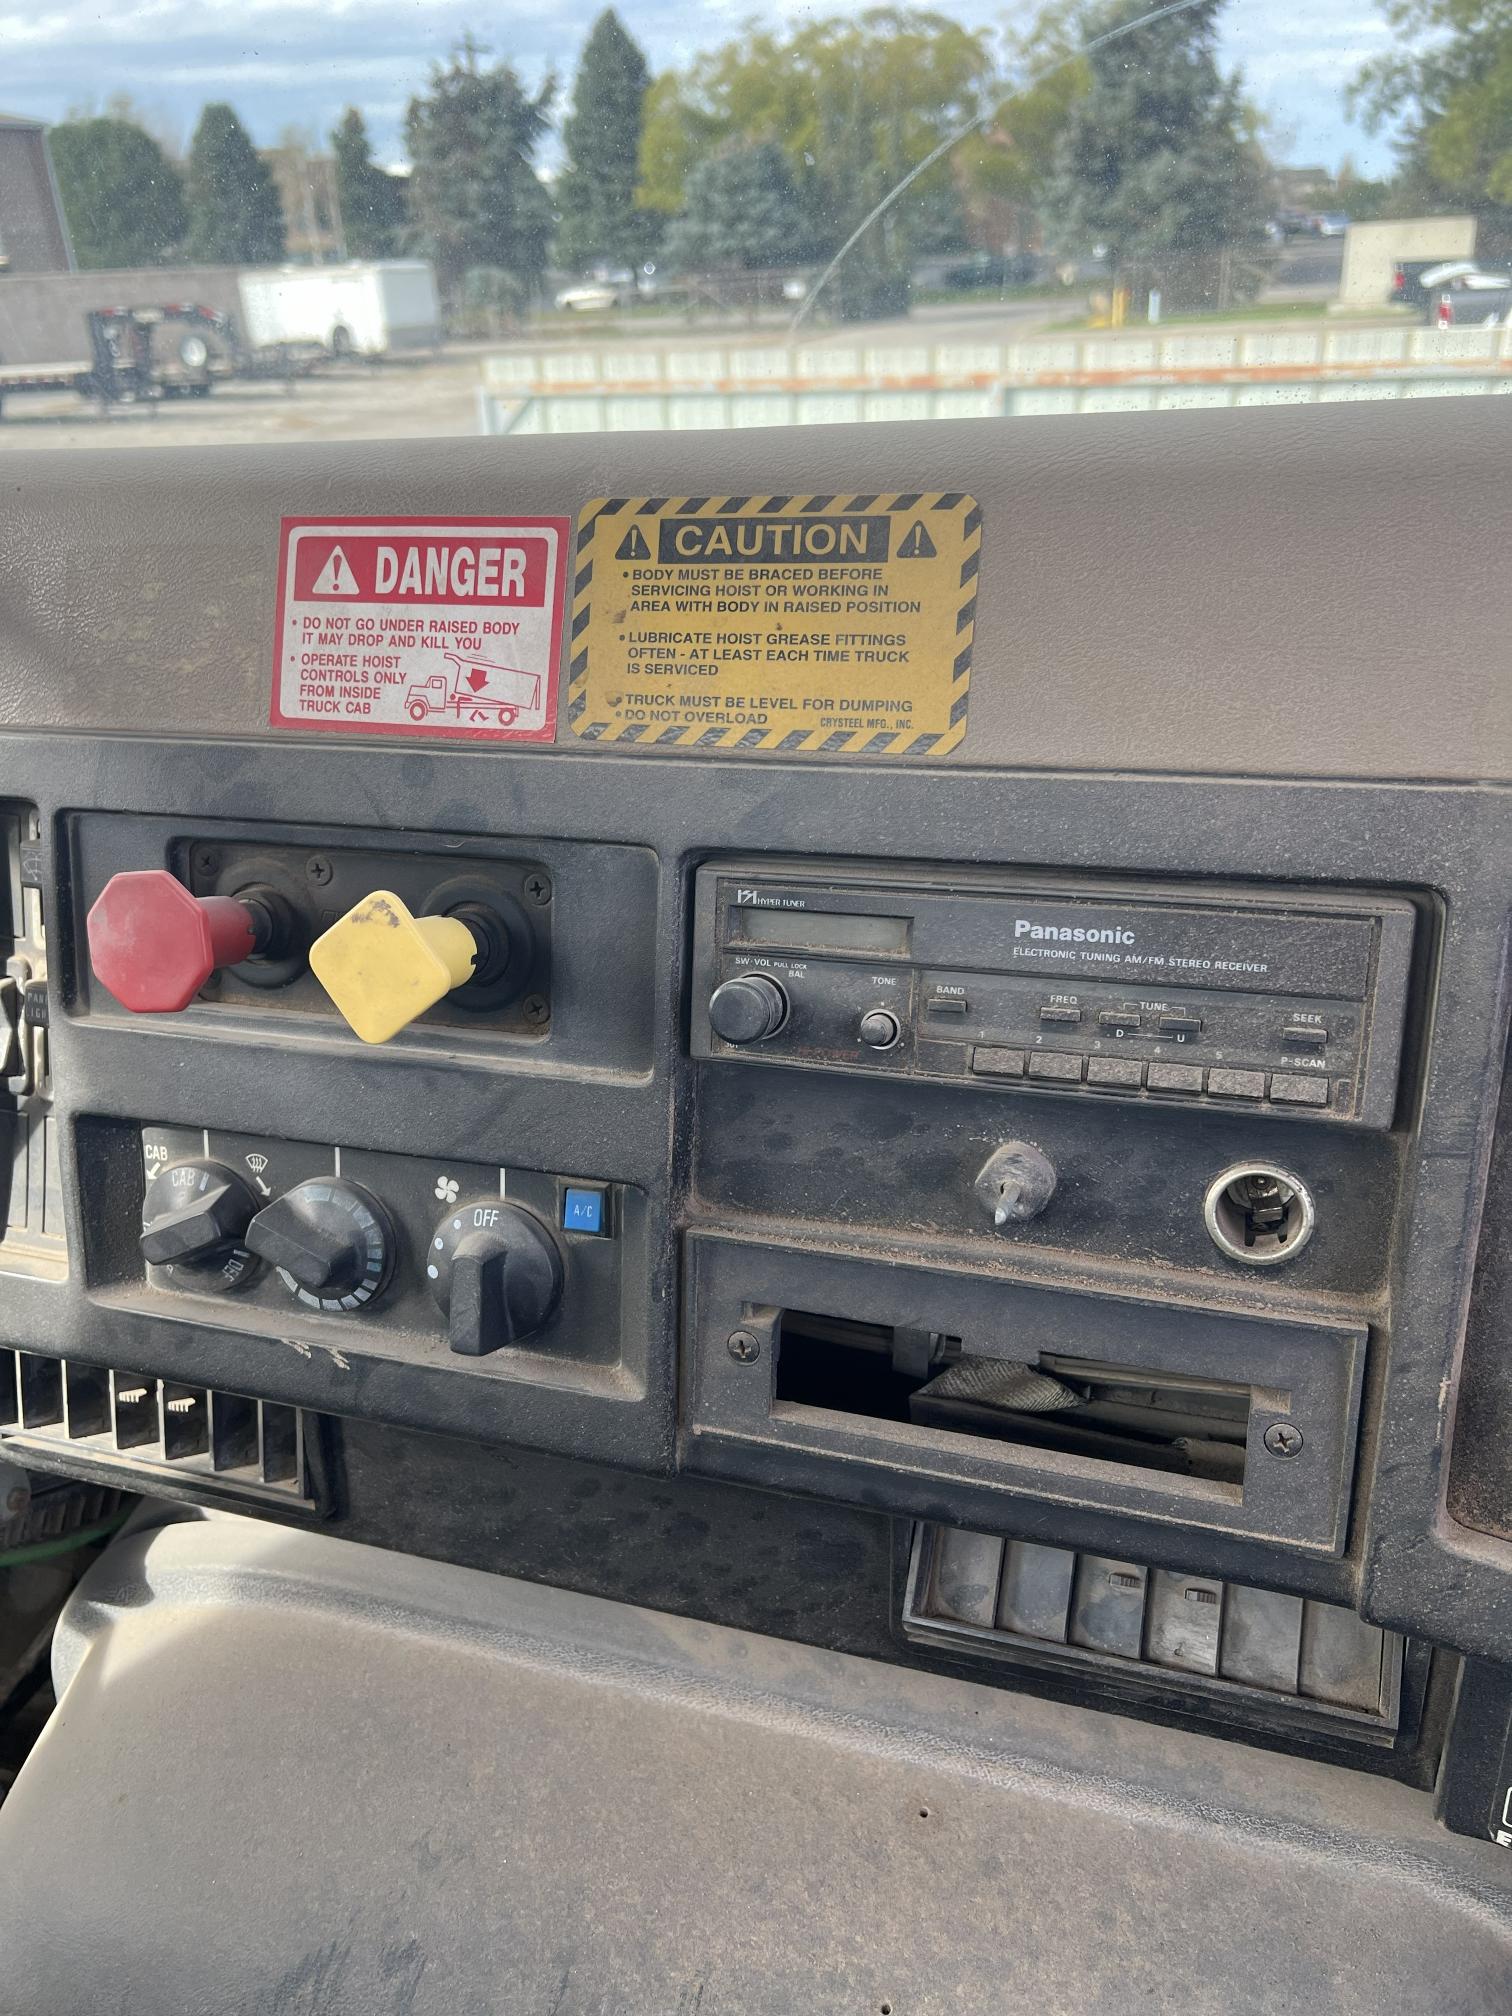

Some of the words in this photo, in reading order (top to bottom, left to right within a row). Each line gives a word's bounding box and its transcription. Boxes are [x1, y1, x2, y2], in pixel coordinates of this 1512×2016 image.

[674, 523, 868, 556] CAUTION
[375, 546, 526, 597] DANGER
[633, 569, 673, 581] BODY
[678, 569, 720, 581] MUST
[724, 569, 745, 580] BE
[749, 569, 814, 580] BRACED
[819, 568, 882, 580] BEFORE
[631, 584, 711, 597] SERVICING
[715, 585, 761, 597] HOIST
[765, 585, 788, 597] OR
[792, 585, 869, 597] WORKING
[873, 584, 888, 597] IN
[630, 600, 671, 613] AREA
[675, 600, 712, 613] WITH
[717, 600, 759, 613] BODY
[764, 600, 779, 613] IN
[784, 600, 842, 613] RAISED
[846, 600, 921, 613] POSITION
[303, 617, 320, 629] DO
[326, 618, 350, 630] NOT
[356, 618, 375, 631] GO
[380, 619, 424, 632] UNDER
[429, 620, 478, 634] RAISED
[483, 621, 520, 635] BODY
[302, 633, 313, 645] IT
[318, 633, 343, 646] MAY
[349, 634, 384, 647] DROP
[389, 635, 416, 648] AND
[421, 636, 449, 649] KILL
[455, 637, 482, 650] YOU
[629, 633, 712, 645] LUBRICATE
[716, 633, 761, 646] HOIST
[766, 633, 831, 646] GREASE
[835, 634, 905, 647] FITTINGS
[301, 654, 357, 667] OPERATE
[363, 655, 401, 668] HOIST
[628, 647, 676, 659] OFTEN
[690, 648, 709, 660] AT
[713, 648, 761, 661] LEAST
[766, 649, 809, 662] EACH
[813, 649, 852, 662] TIME
[856, 650, 909, 663] TRUCK
[627, 663, 641, 676] IS
[644, 664, 718, 676] SERVICED
[301, 669, 368, 683] CONTROLS
[374, 672, 407, 685] ONLY
[300, 685, 334, 698] FROM
[340, 686, 381, 699] INSIDE
[300, 700, 340, 713] TRUCK
[346, 702, 371, 714] CAB
[625, 693, 676, 706] TRUCK
[679, 695, 721, 707] MUST
[725, 696, 745, 708] BE
[750, 697, 798, 710] LEVEL
[802, 698, 835, 711] FOR
[839, 699, 913, 713] DUMPING
[625, 709, 646, 721] DO
[649, 710, 680, 722] NOT
[684, 711, 768, 725] OVERLOAD
[820, 718, 865, 729] CRYSTEEL
[896, 720, 914, 729] INC.
[758, 898, 780, 906] HYPER
[1014, 919, 1135, 945] Panasonic
[1013, 946, 1076, 960] ELECTRONIC
[1080, 951, 1121, 963] TUNING
[1125, 954, 1165, 966] AM/FM
[1168, 957, 1211, 969] STEREO
[1215, 960, 1267, 973] RECEIVER
[789, 970, 805, 978] BAL
[872, 976, 897, 986] TONE
[936, 985, 964, 996] BAND
[1050, 994, 1077, 1005] FREQ
[1140, 1001, 1168, 1012] TUNE
[1293, 1013, 1322, 1024] SEEK
[1036, 1035, 1042, 1044] 2
[1116, 1029, 1124, 1038] D
[1177, 1033, 1185, 1043] U
[1094, 1040, 1101, 1049] 3
[1154, 1046, 1161, 1055] 4
[1215, 1051, 1223, 1060] 5
[1280, 1056, 1326, 1069] P-SCAN
[145, 1145, 168, 1161] CAB
[172, 1169, 196, 1186] CAB
[573, 1204, 593, 1218] A/C
[473, 1209, 499, 1227] OFF
